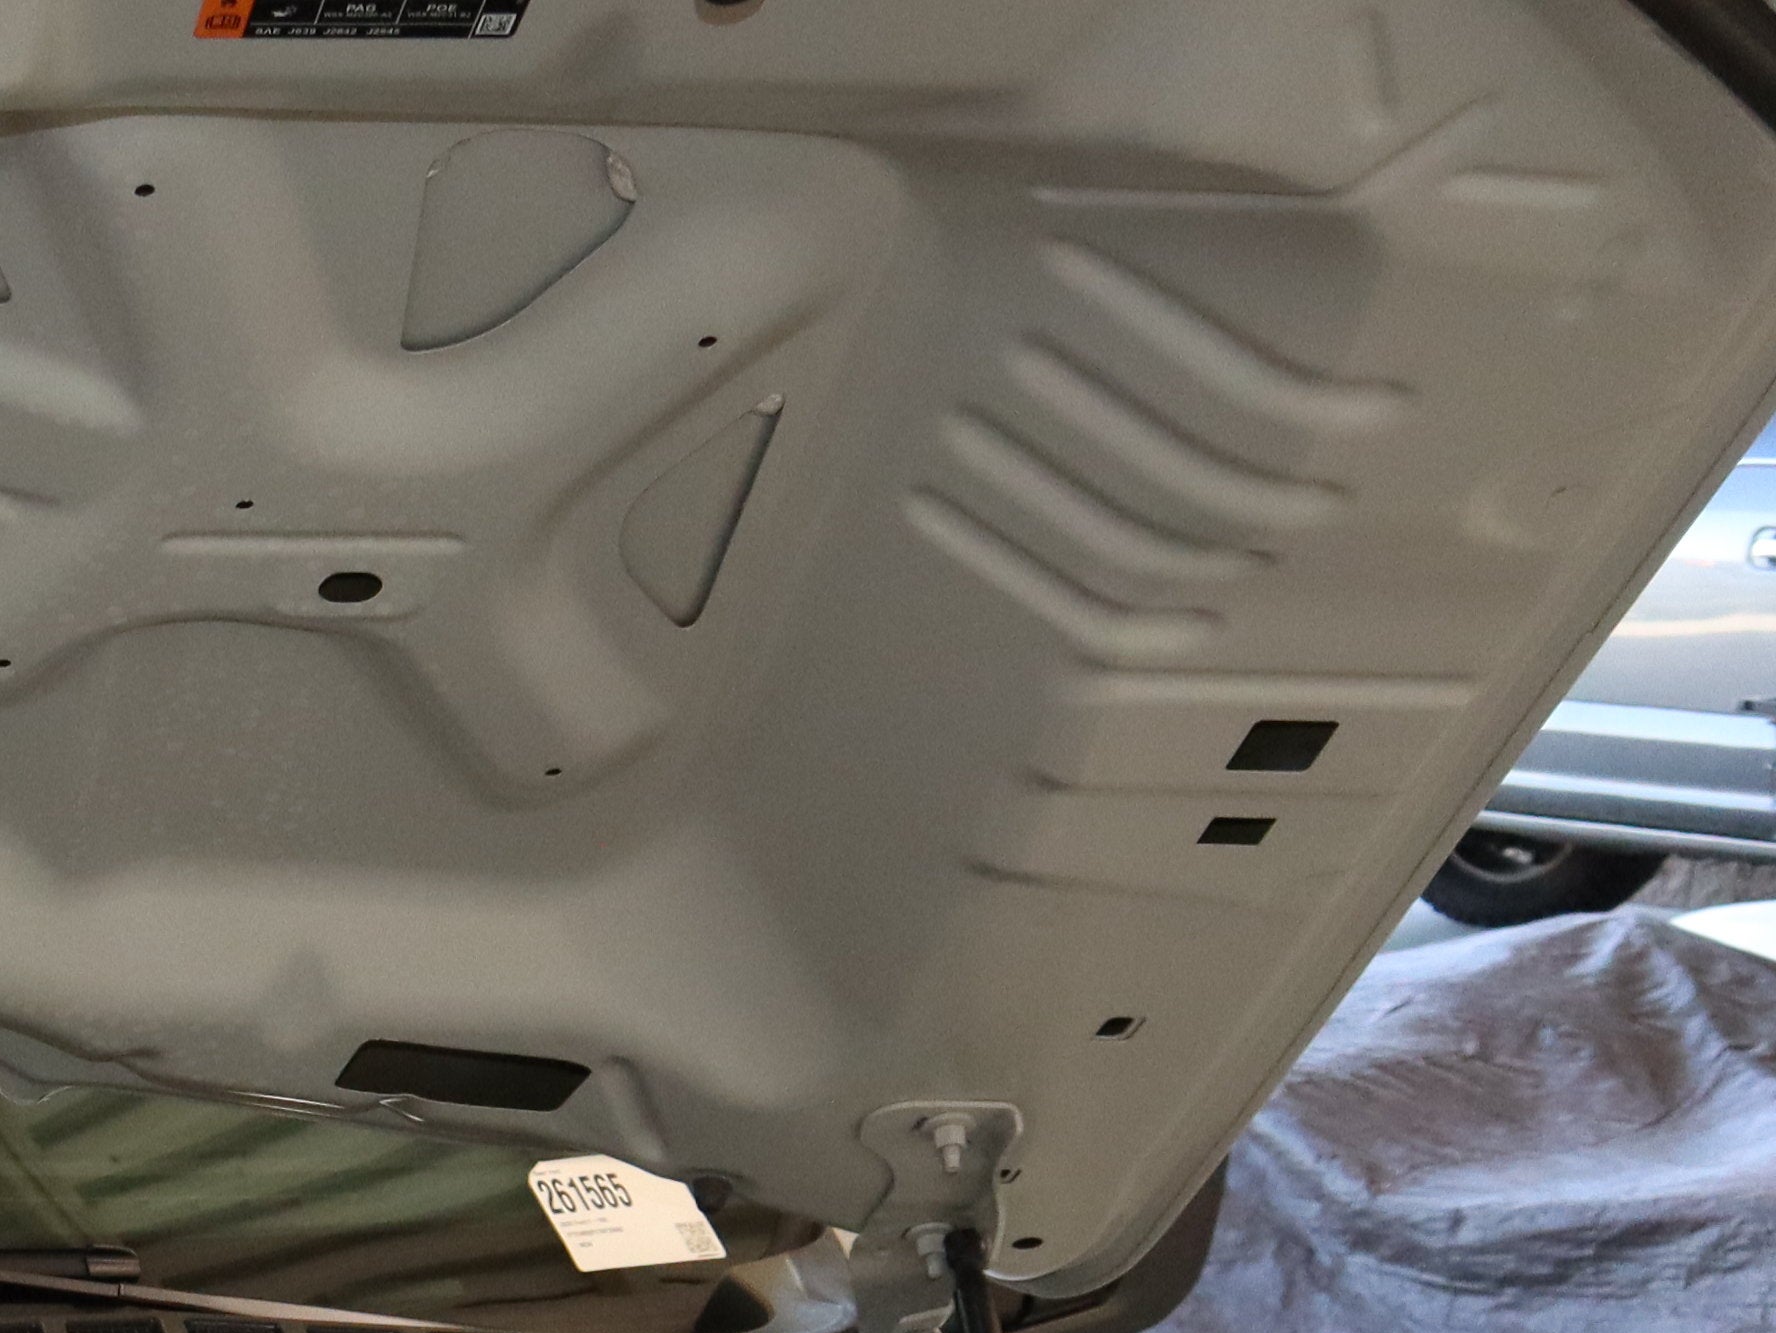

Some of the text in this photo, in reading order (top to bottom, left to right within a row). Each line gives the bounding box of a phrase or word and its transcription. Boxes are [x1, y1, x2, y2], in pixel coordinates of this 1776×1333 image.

[346, 4, 377, 12] PAG
[426, 4, 458, 12] POE
[537, 1172, 633, 1215] 261565
